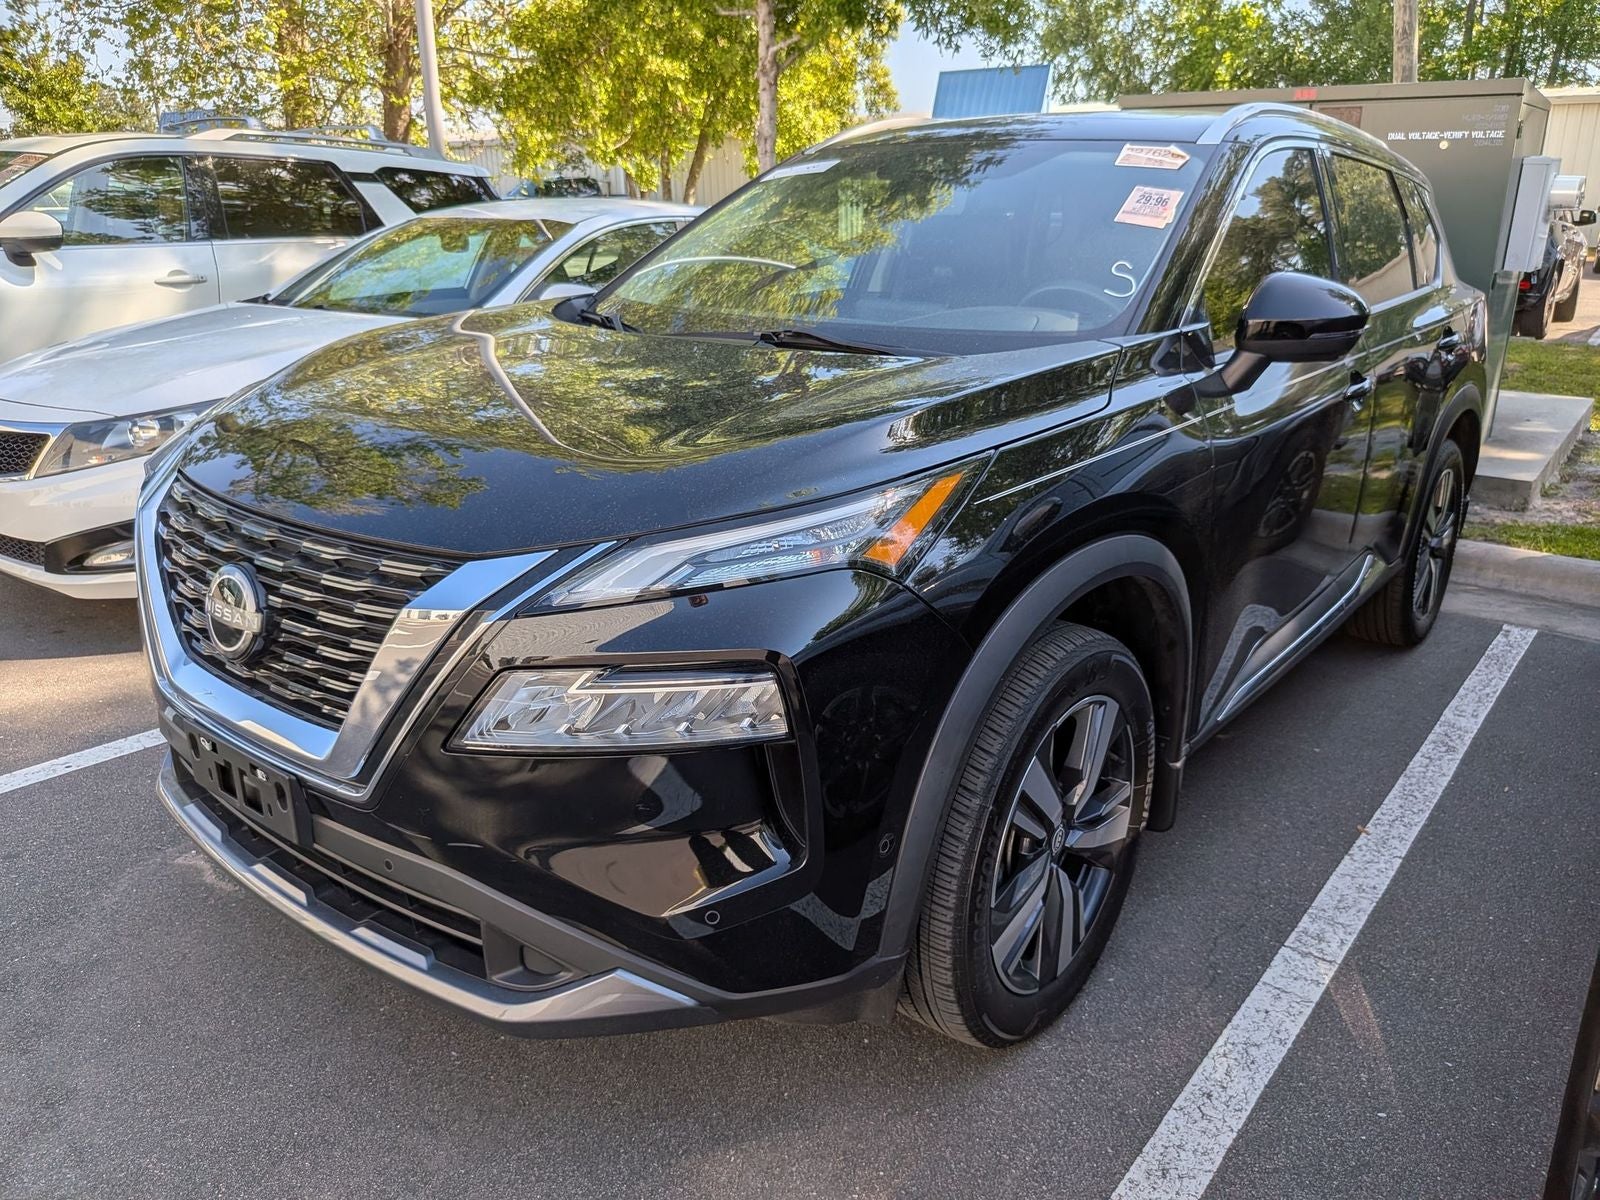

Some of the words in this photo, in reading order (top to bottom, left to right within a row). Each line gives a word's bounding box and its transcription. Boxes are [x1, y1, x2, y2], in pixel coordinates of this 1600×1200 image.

[1387, 132, 1406, 140] DUAL
[1408, 131, 1470, 140] VOLTAGE-VERIFY
[1471, 130, 1505, 139] VOLTAGE
[1103, 261, 1136, 298] S
[206, 596, 258, 629] NISSAN
